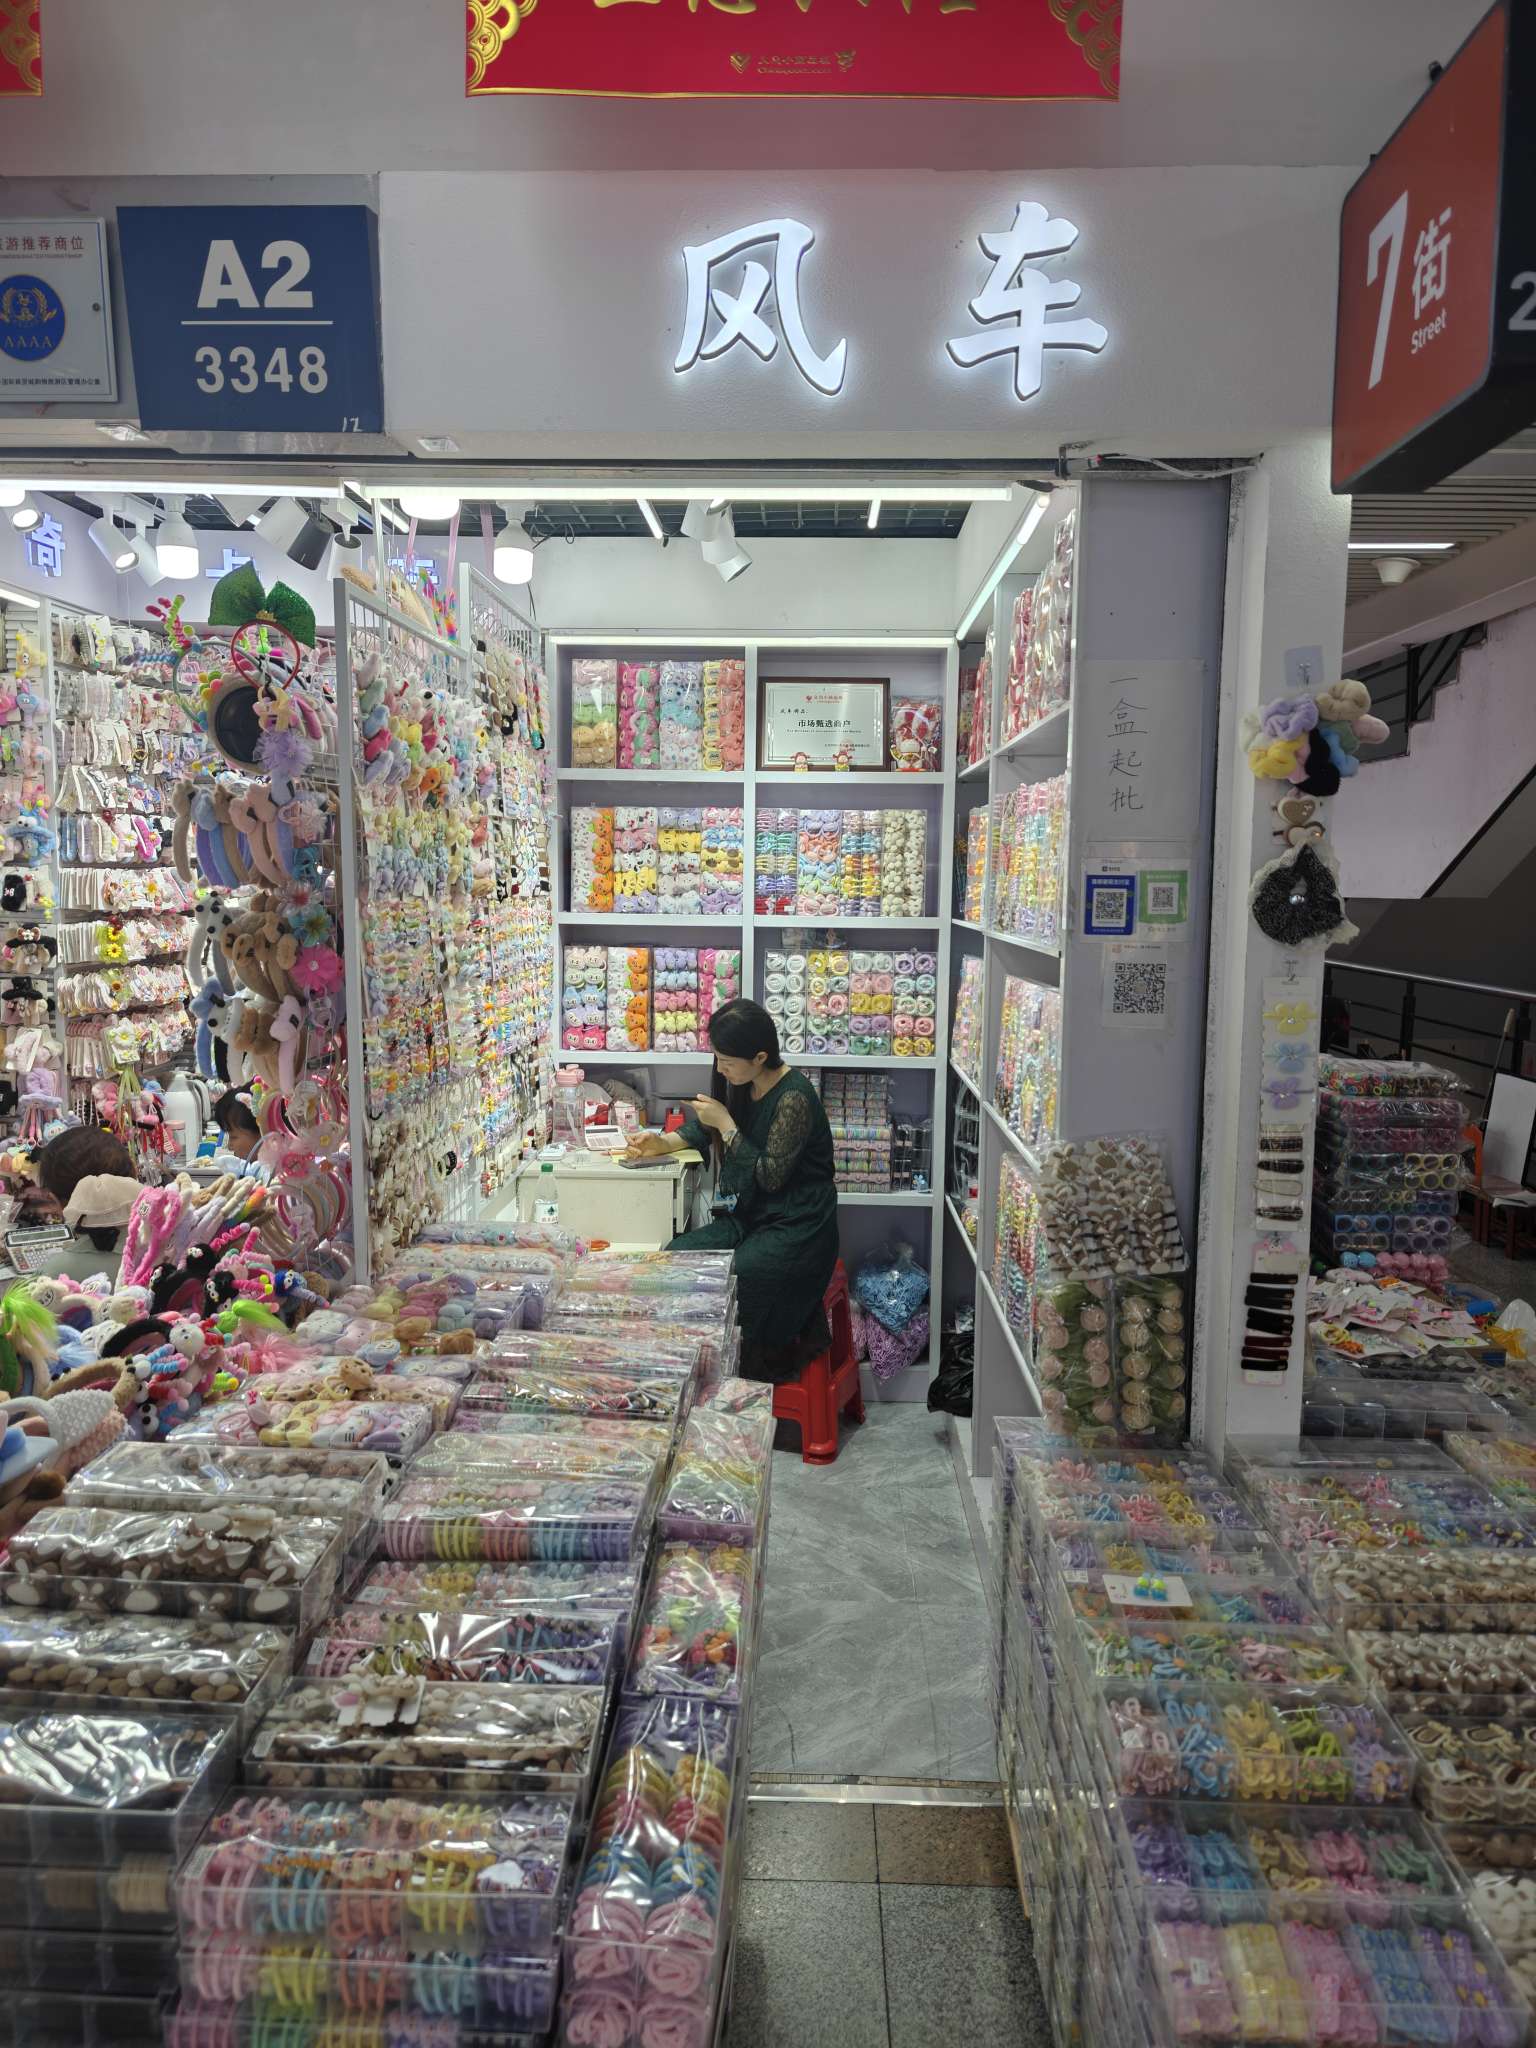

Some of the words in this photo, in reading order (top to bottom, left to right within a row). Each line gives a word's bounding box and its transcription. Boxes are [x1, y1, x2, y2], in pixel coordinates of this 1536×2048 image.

[0, 234, 85, 251] 游推荐商位
[196, 238, 314, 309] A2
[1412, 206, 1452, 321] 街
[674, 200, 1109, 402] 风车
[1411, 307, 1447, 355] Street
[194, 345, 329, 394] 3348
[1107, 675, 1149, 812] 一盒起批
